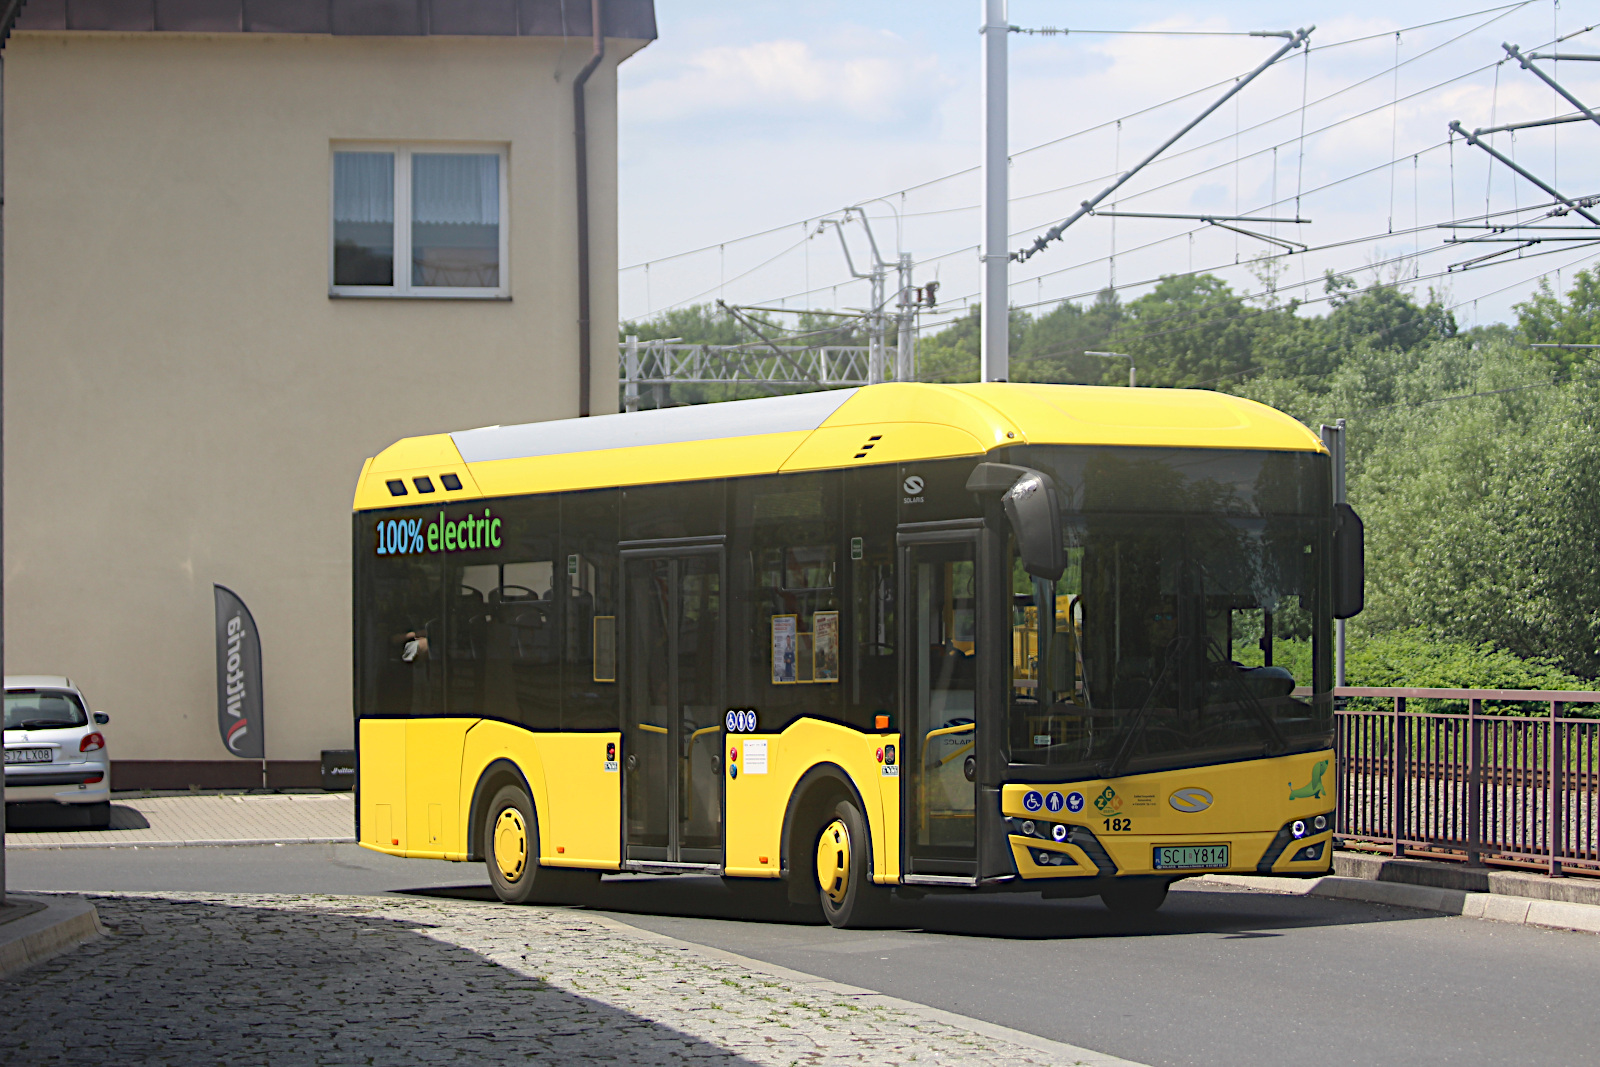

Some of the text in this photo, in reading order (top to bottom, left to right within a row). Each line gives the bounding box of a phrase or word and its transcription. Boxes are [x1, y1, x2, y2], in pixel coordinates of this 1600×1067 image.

[903, 496, 925, 504] SOLARIS
[376, 508, 501, 554] 100% electric
[4, 749, 50, 761] SJZ LX08
[1103, 818, 1132, 832] 182
[1163, 848, 1224, 864] SCI Y814
